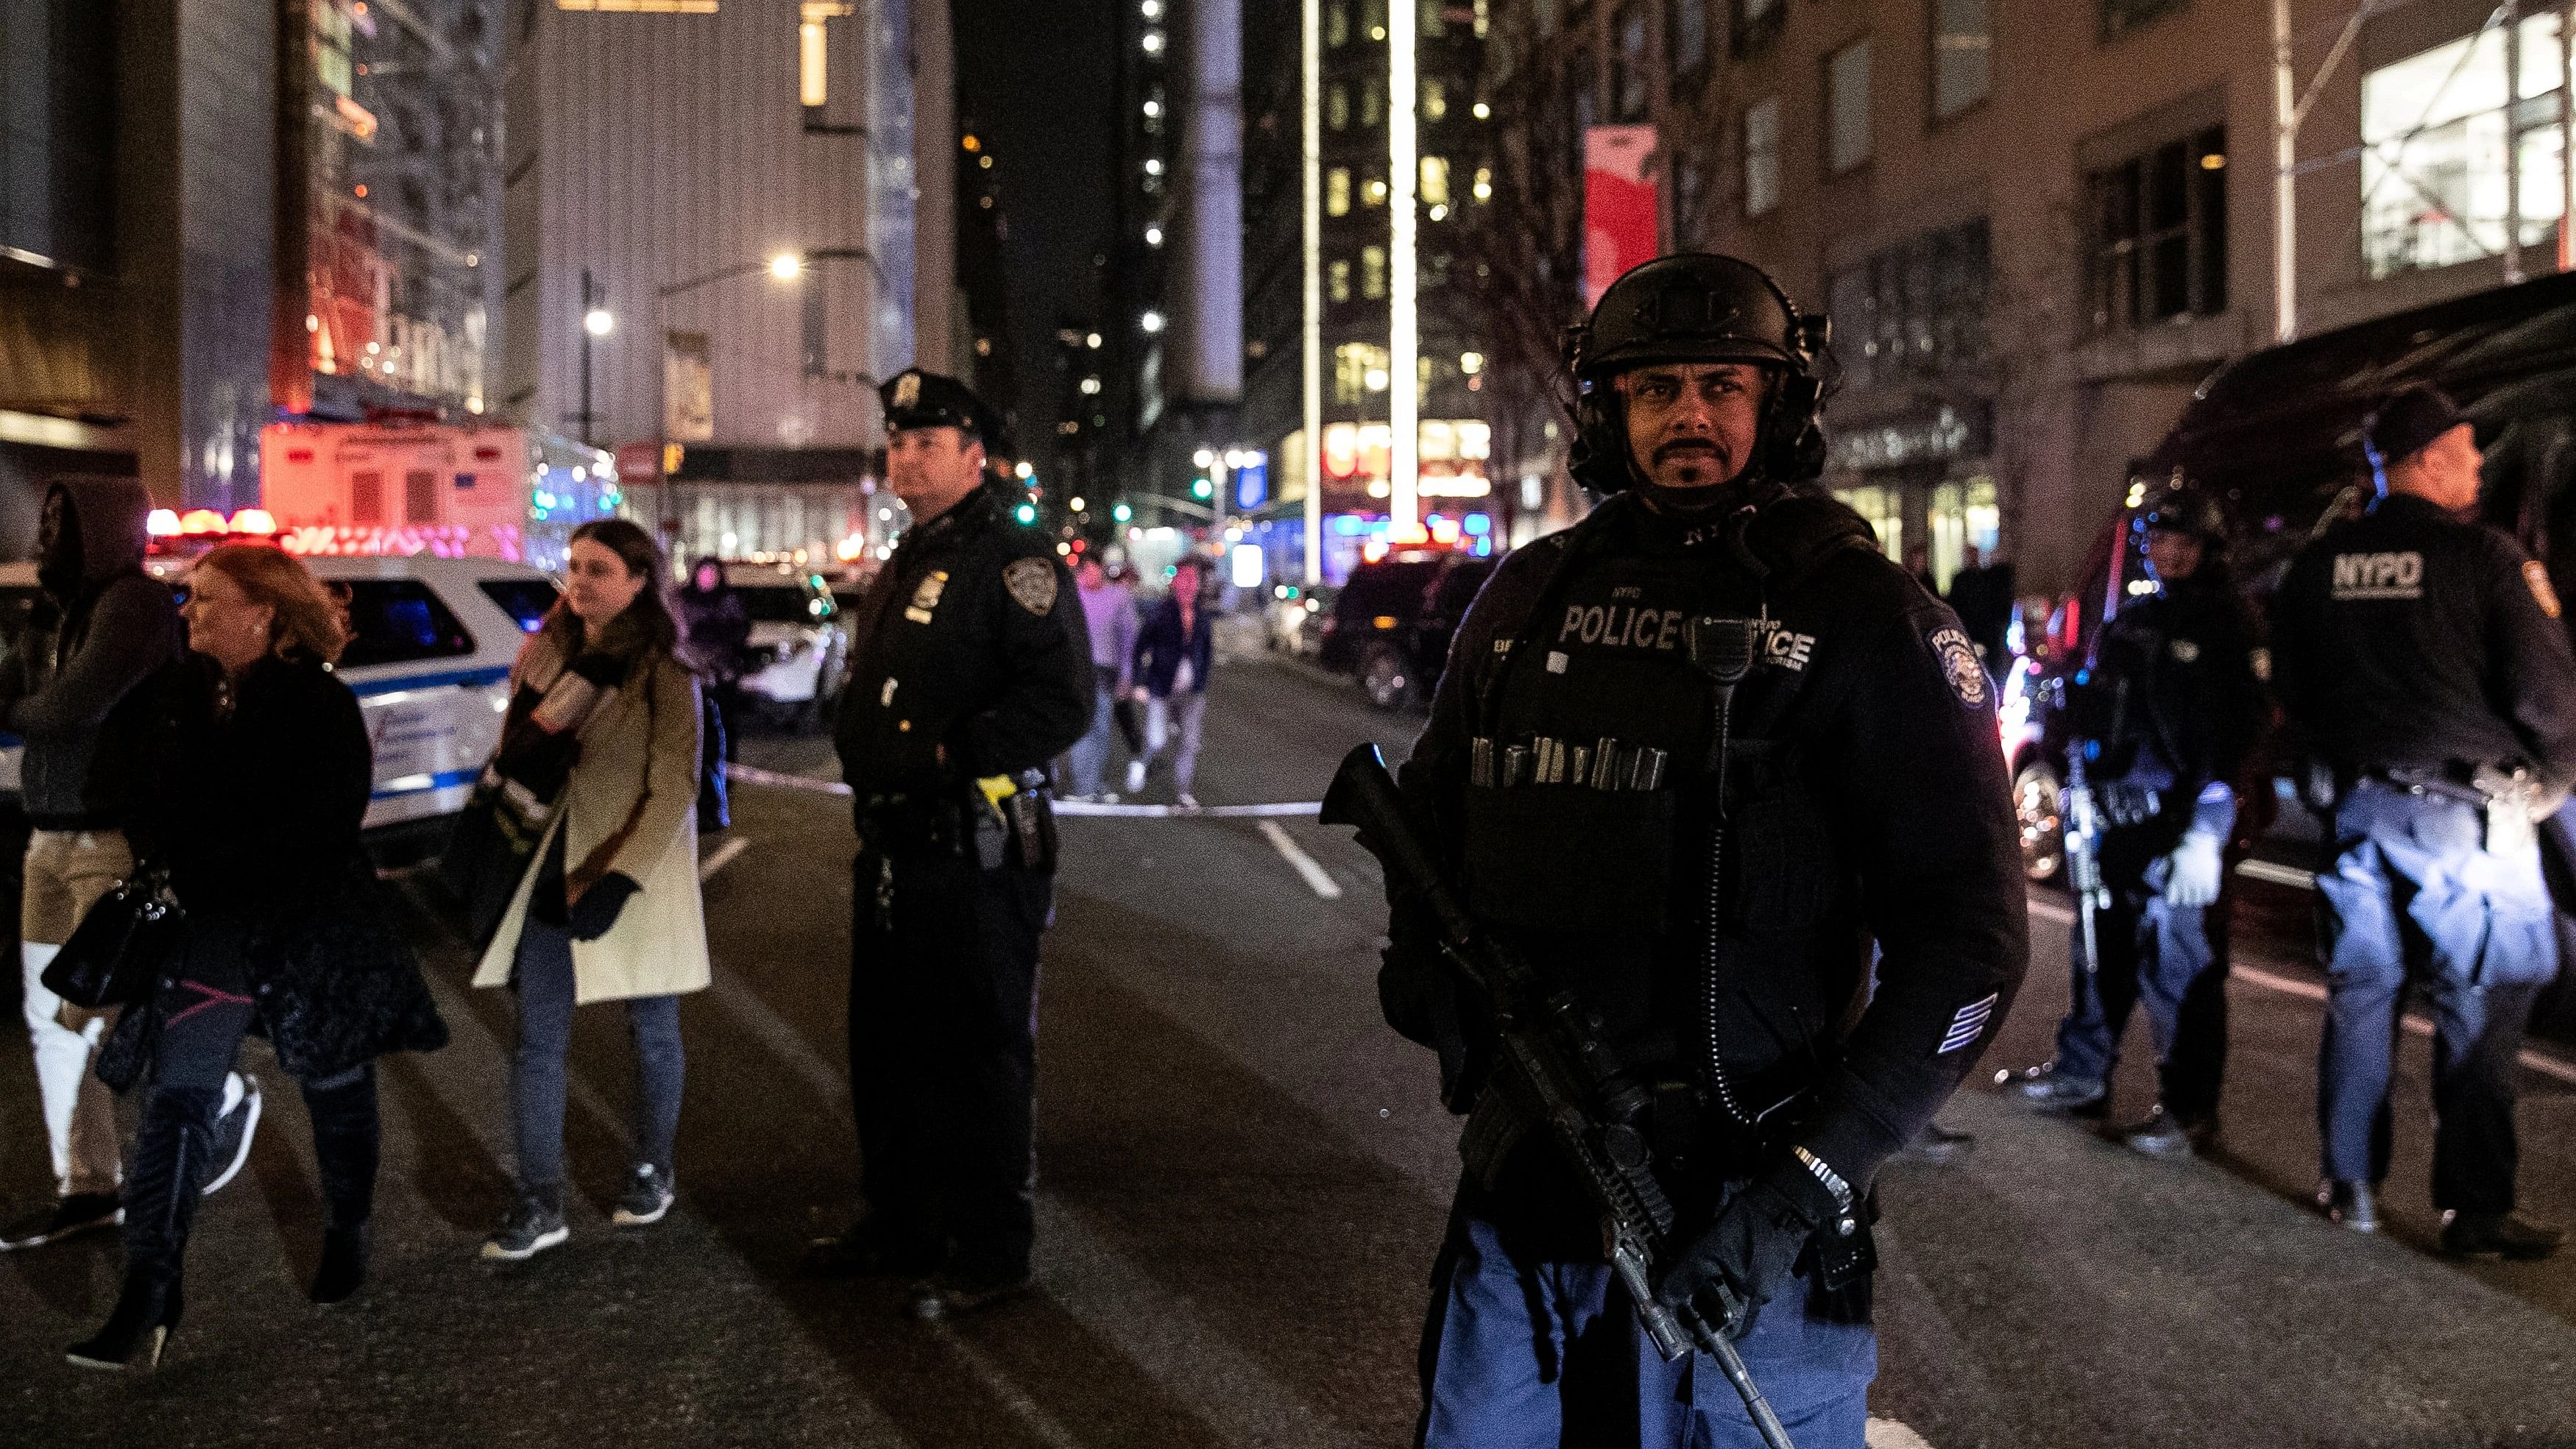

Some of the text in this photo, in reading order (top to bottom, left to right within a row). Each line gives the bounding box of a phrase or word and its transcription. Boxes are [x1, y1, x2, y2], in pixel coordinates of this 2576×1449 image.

[2332, 550, 2424, 587] NYPD
[1558, 604, 1683, 650] POLICE
[1764, 630, 1816, 663] ICE
